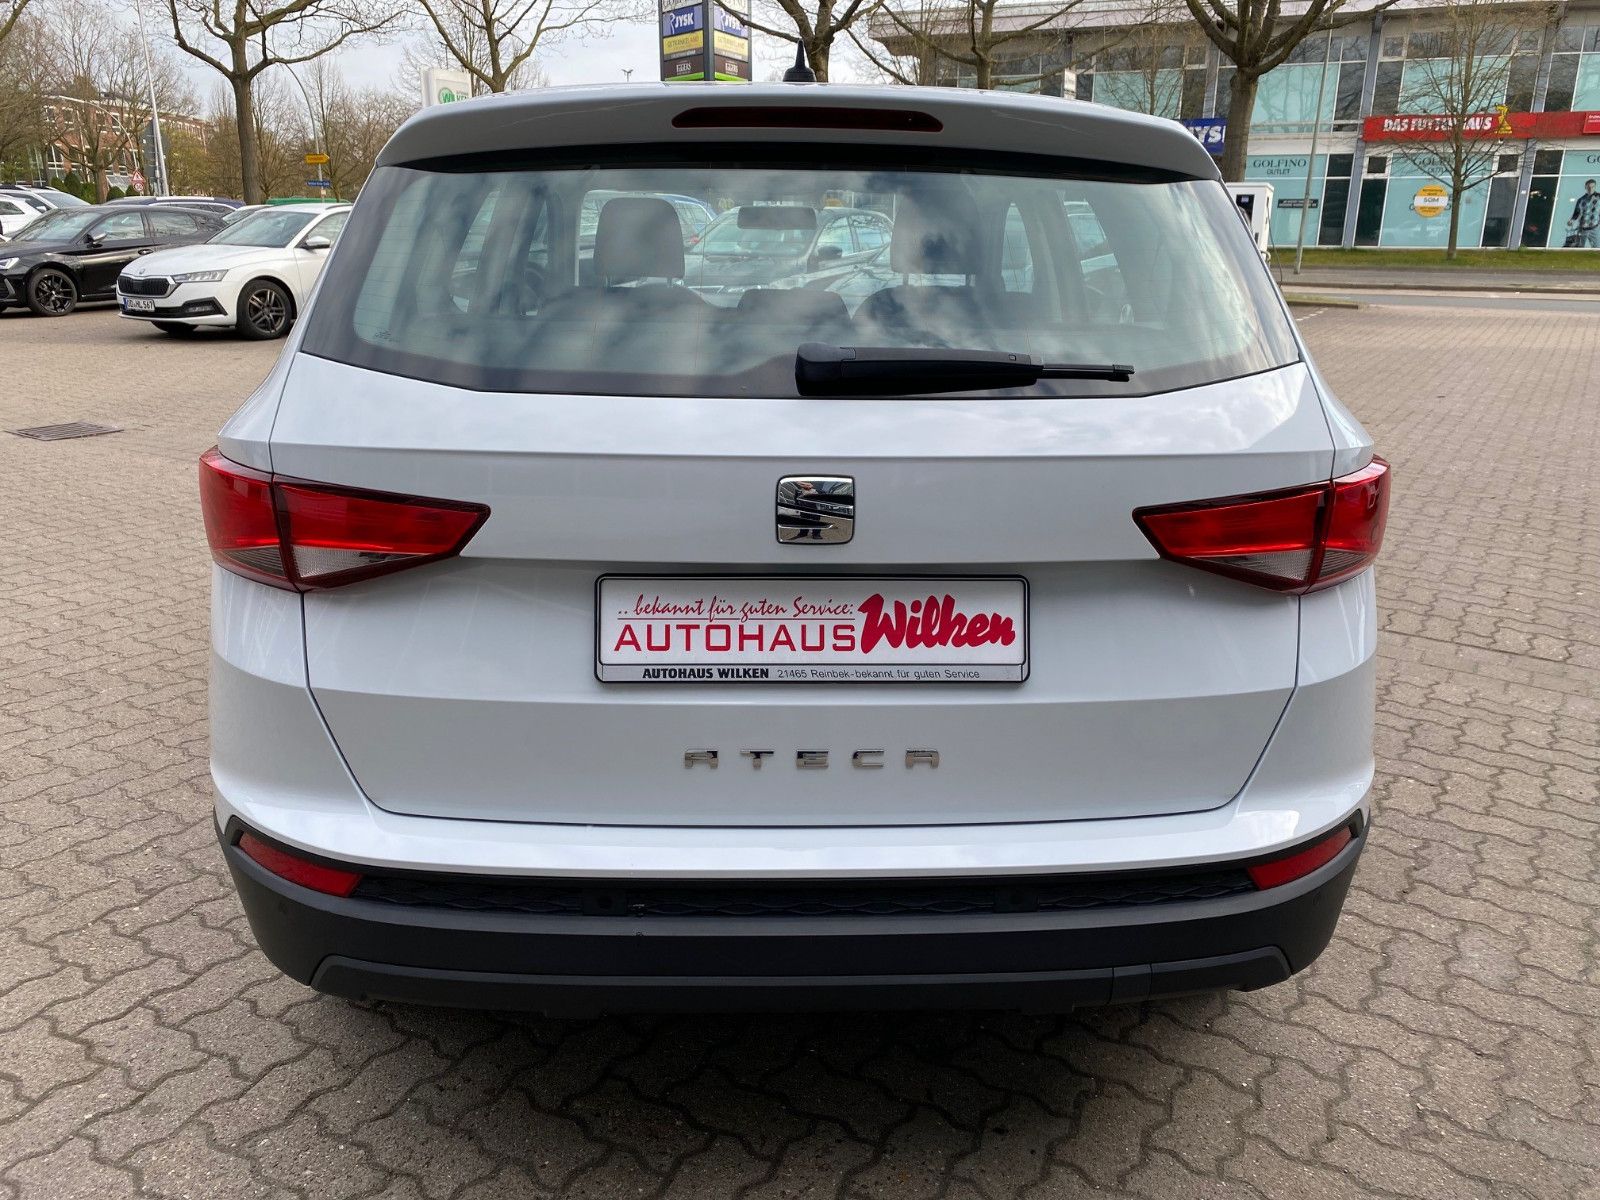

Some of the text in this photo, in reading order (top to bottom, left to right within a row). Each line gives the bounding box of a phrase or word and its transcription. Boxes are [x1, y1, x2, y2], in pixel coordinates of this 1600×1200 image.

[674, 12, 694, 28] JYSK
[1383, 116, 1493, 132] DAS FUTTERAUS
[1187, 126, 1227, 143] YS
[1253, 158, 1307, 168] GOLFINO
[634, 594, 704, 616] bekannt
[707, 596, 736, 622] für
[739, 599, 787, 623] guten
[793, 596, 853, 618] Service:
[614, 593, 1016, 654] AUTOHAUS Wilken
[642, 668, 713, 679] AUTOHAUS
[717, 668, 769, 679] WILKEN
[777, 669, 807, 679] 21465
[897, 669, 910, 679] für
[914, 670, 940, 681] guten
[944, 669, 980, 679] Service
[684, 749, 940, 769] ATECA
